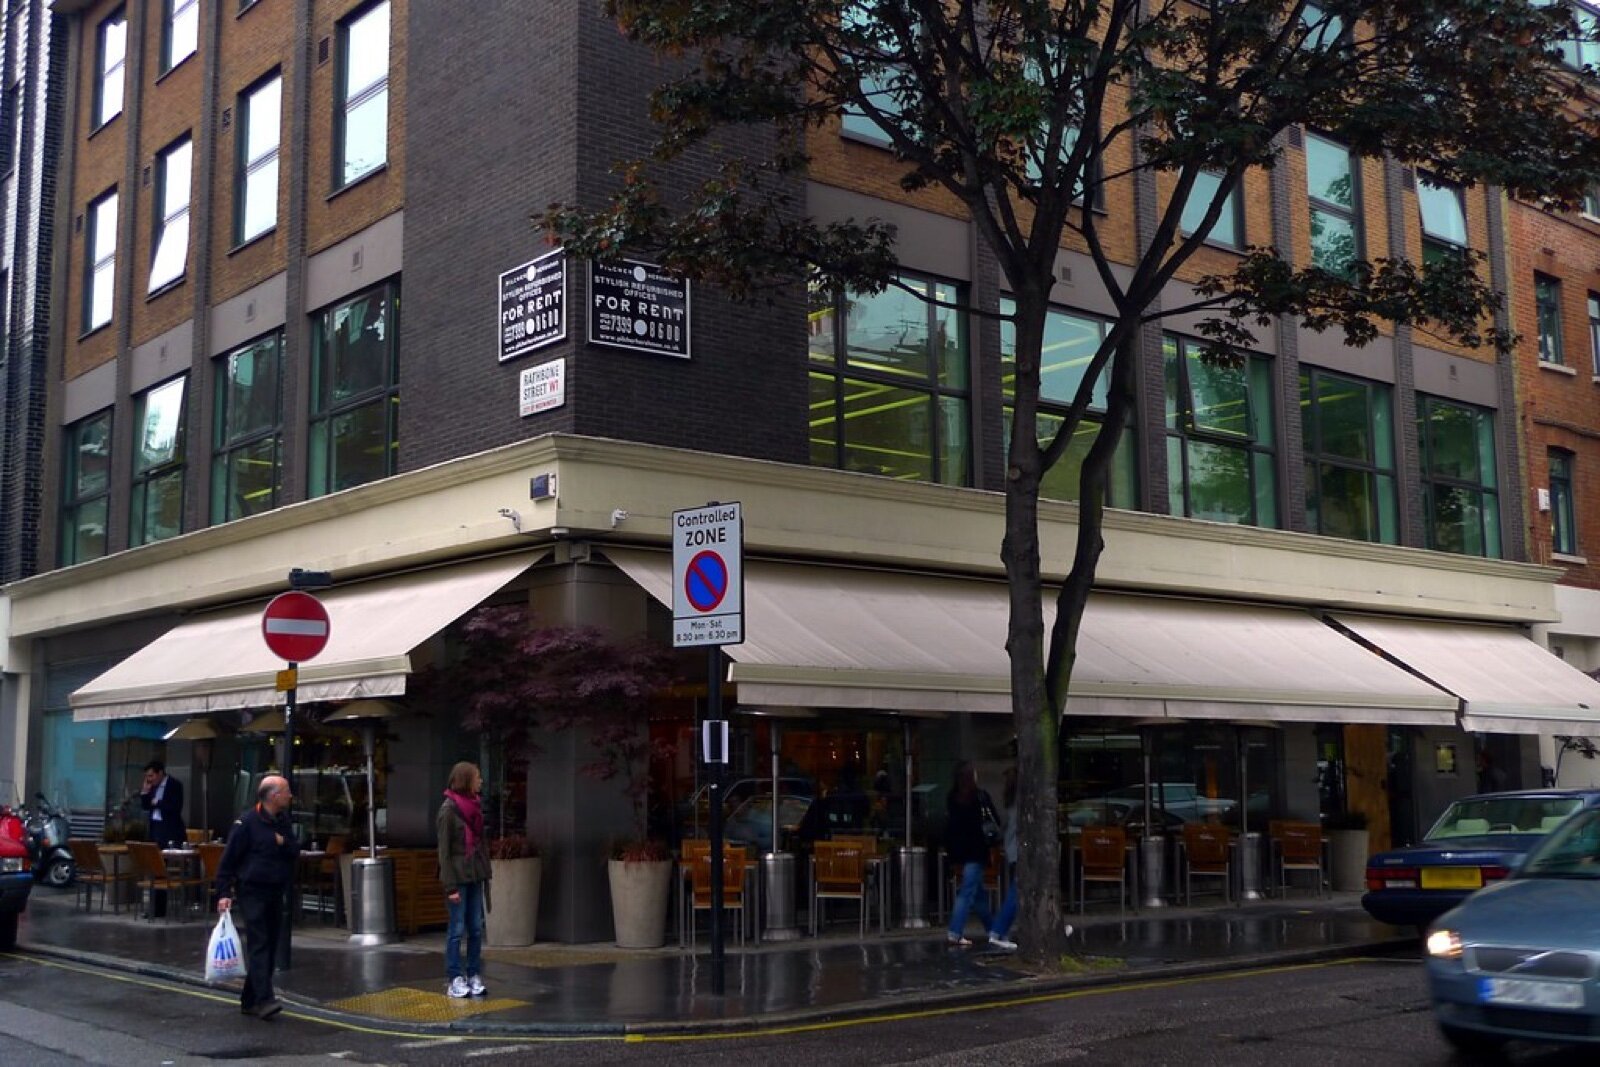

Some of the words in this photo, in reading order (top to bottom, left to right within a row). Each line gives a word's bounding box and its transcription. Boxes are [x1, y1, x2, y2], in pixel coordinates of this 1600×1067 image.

[595, 275, 629, 288] STYLISH
[631, 282, 684, 299] REFURBISHED
[624, 288, 656, 301] OFFICES
[502, 304, 524, 324] FOR
[527, 290, 562, 314] RENT
[595, 294, 631, 313] FOR
[639, 302, 684, 321] RENT
[524, 364, 559, 386] RATHBONE
[523, 382, 547, 401] STREET
[549, 379, 559, 393] W1
[677, 507, 735, 528] Controlled
[685, 527, 726, 547] ZONE
